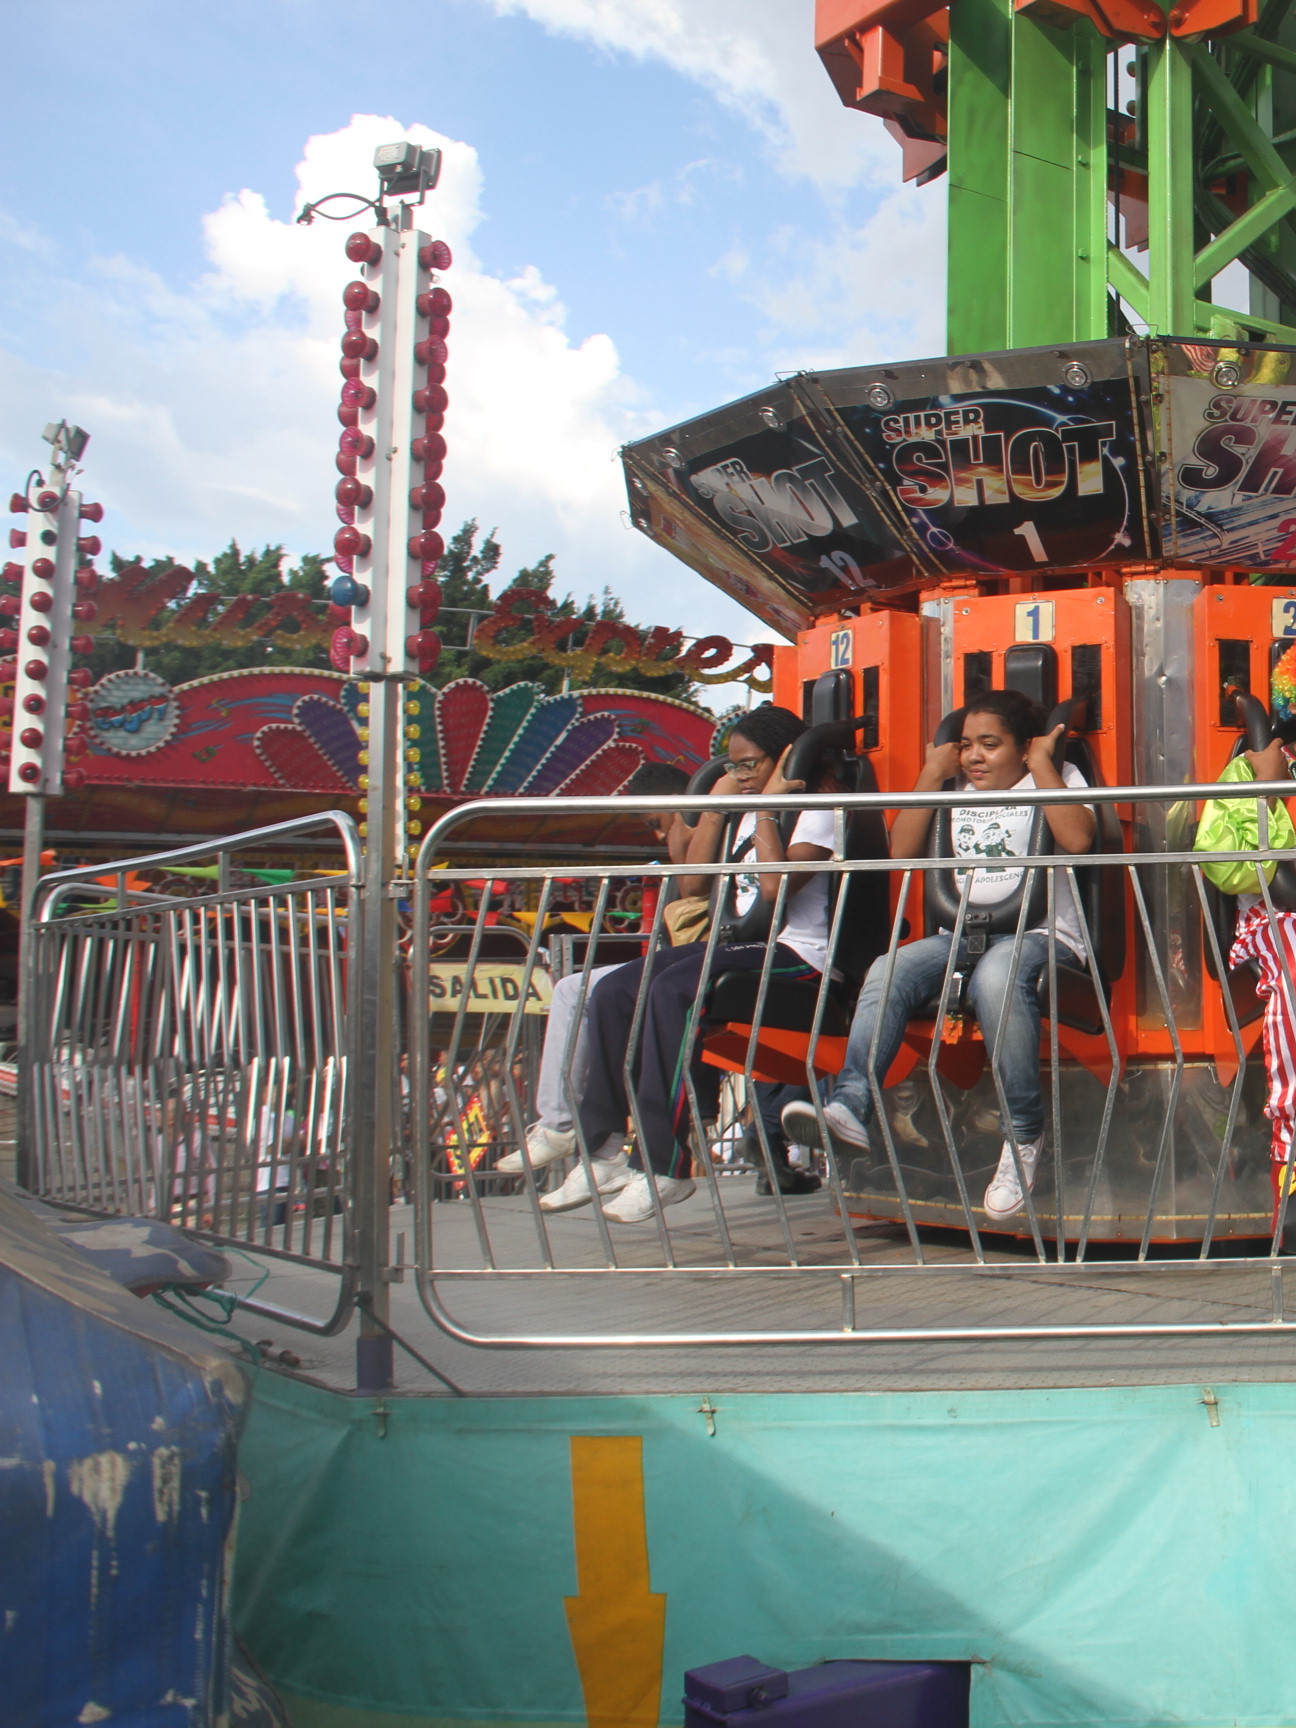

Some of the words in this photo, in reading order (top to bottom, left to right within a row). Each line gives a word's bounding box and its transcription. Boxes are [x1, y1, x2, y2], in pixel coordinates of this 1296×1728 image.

[882, 406, 984, 443] SUPER
[892, 421, 1116, 508] SHOT
[713, 456, 859, 553] SHOT
[1013, 520, 1049, 562] 1
[819, 550, 875, 591] 12
[1026, 604, 1040, 641] 1
[831, 631, 851, 667] 12
[429, 975, 543, 1001] SALIDA
